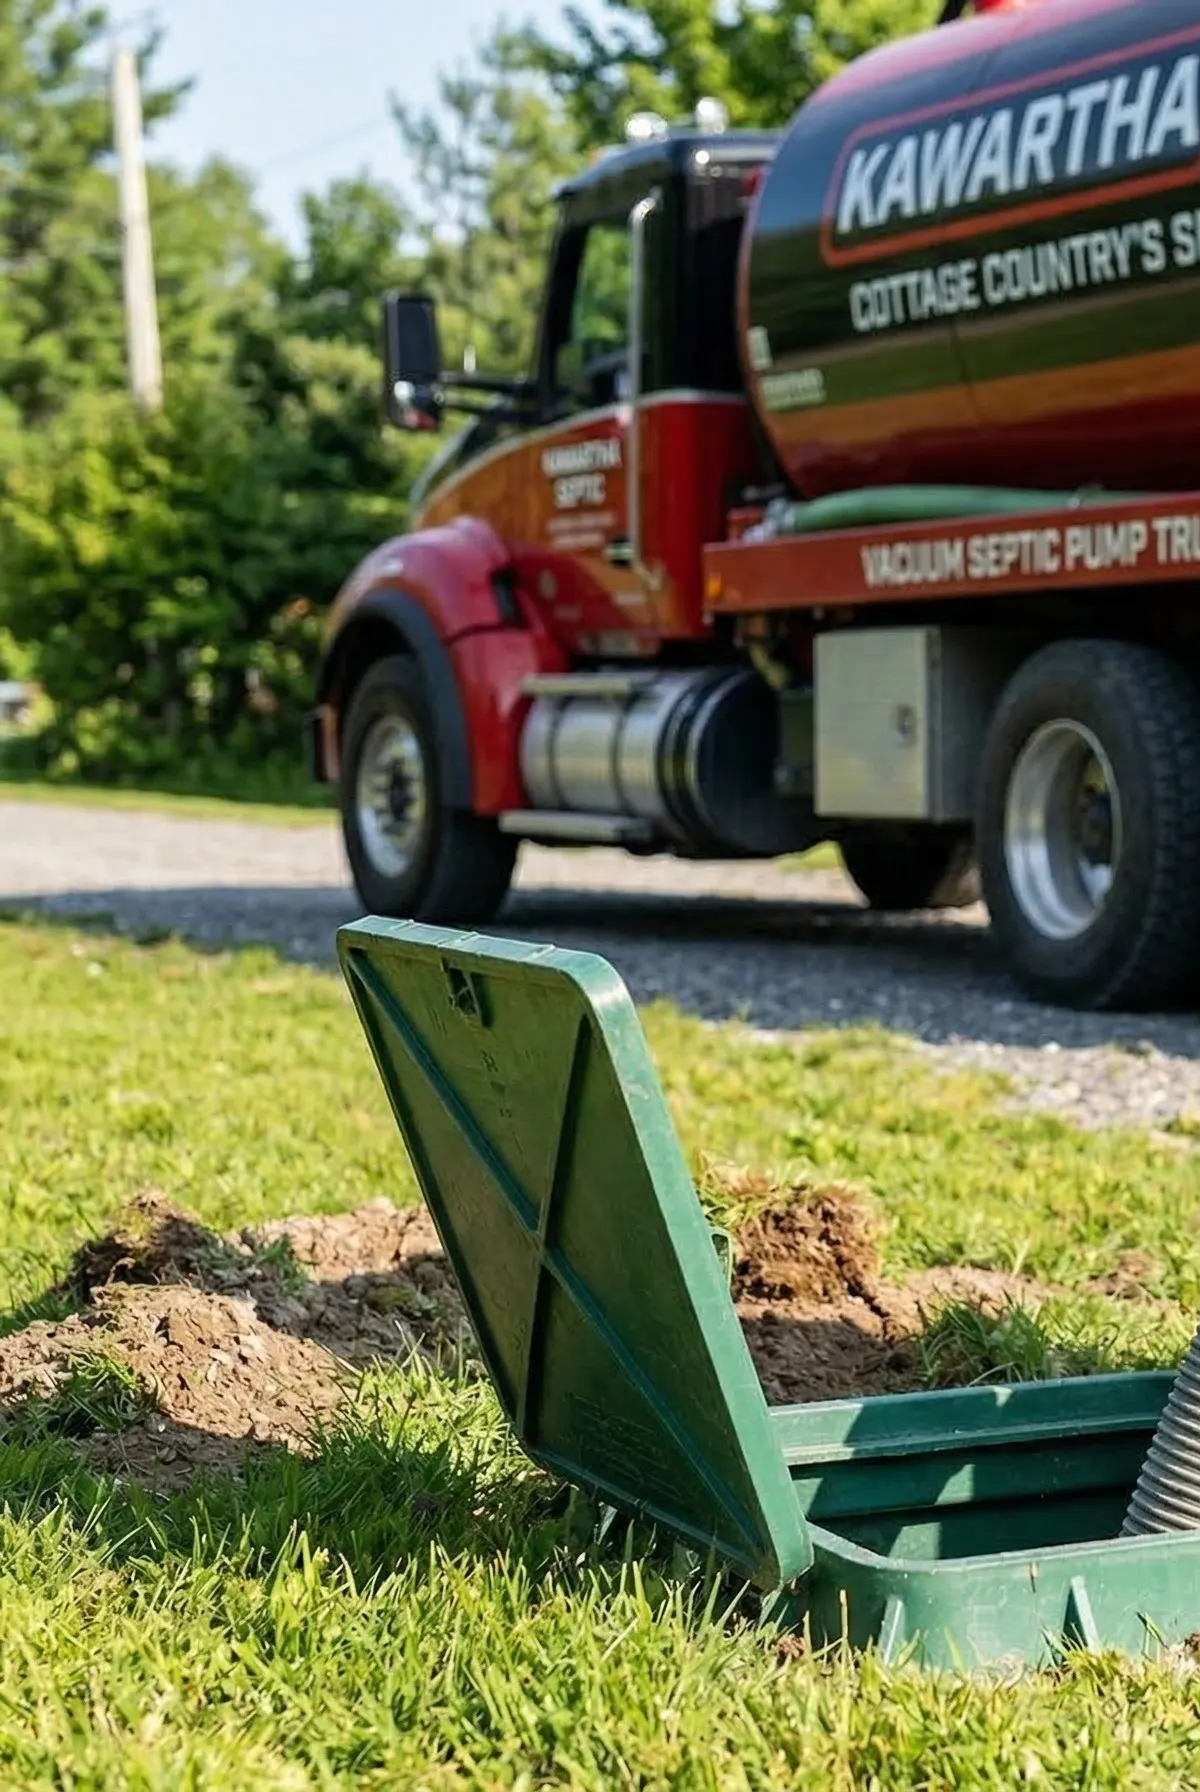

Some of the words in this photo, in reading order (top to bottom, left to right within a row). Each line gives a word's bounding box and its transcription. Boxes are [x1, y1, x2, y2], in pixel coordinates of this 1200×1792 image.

[836, 54, 1200, 234] KAWARTHA
[849, 259, 982, 331] COTTAGE
[983, 218, 1168, 304] COUNTRY'S
[966, 526, 1061, 578] SEPTIC
[1064, 521, 1148, 571] PUMP
